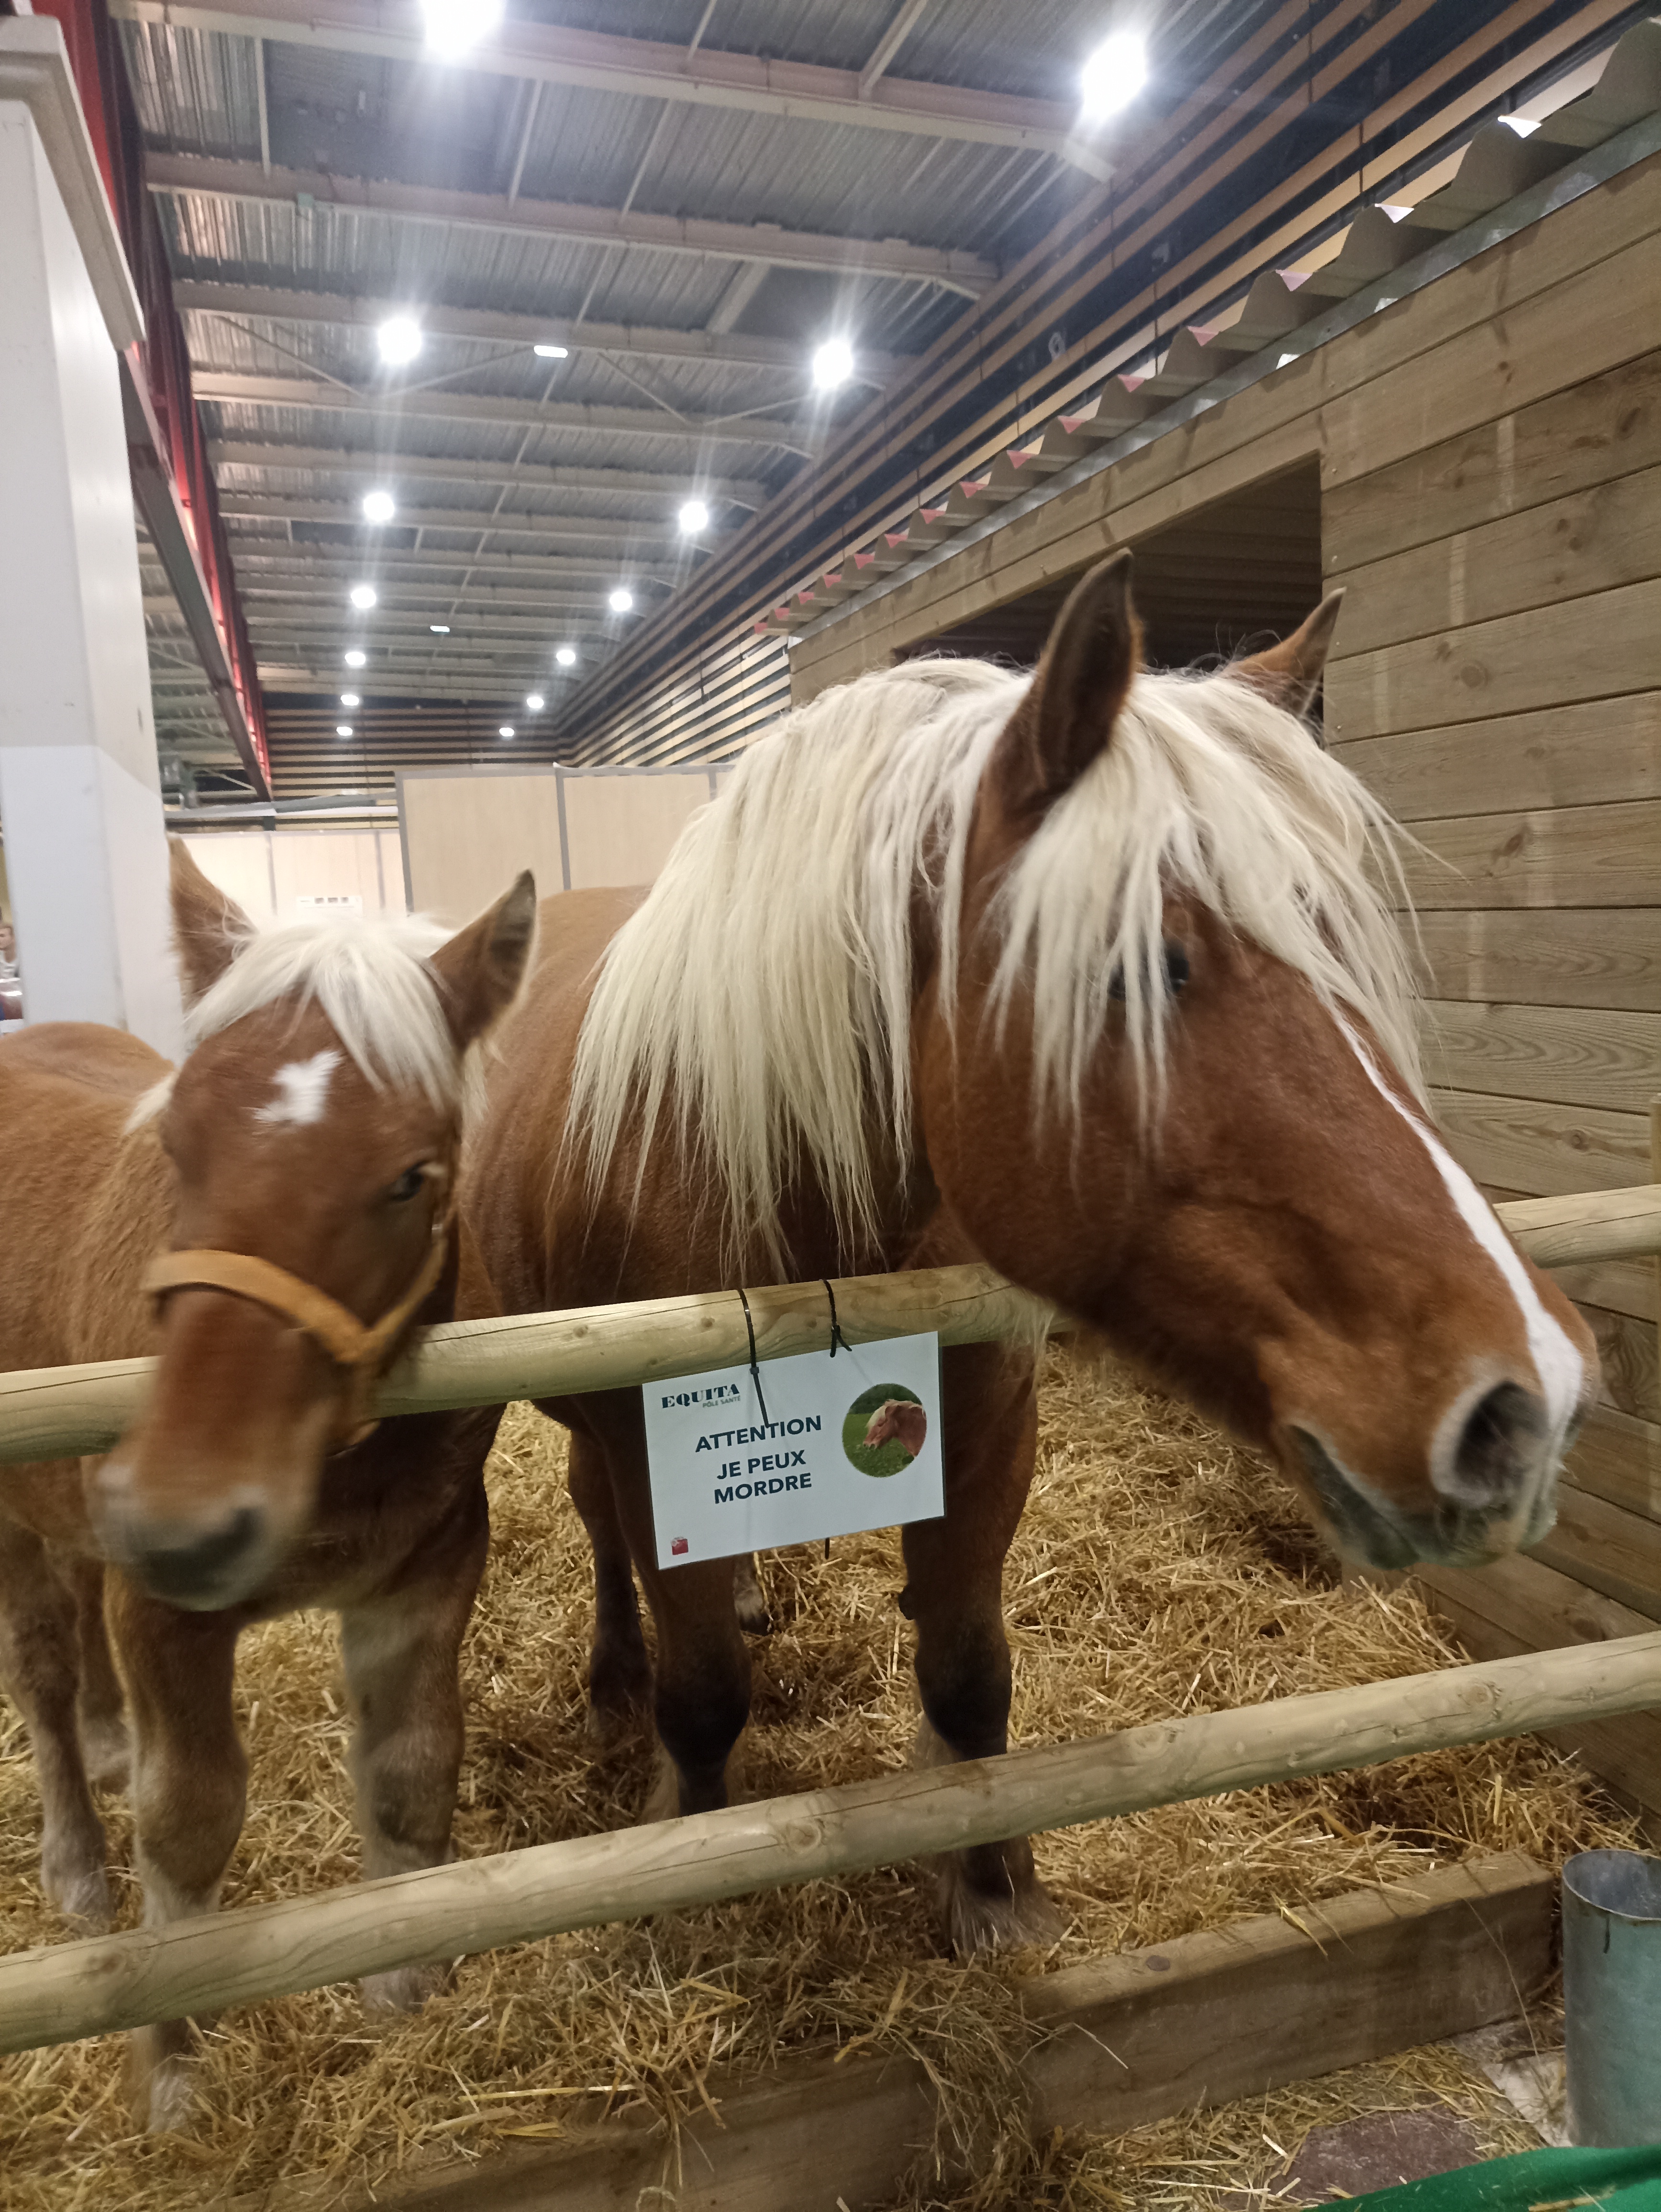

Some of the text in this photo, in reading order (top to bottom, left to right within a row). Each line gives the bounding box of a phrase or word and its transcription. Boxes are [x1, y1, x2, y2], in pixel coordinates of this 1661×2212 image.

[662, 1384, 740, 1408] EQUITA
[702, 1400, 719, 1408] PÔLE
[695, 1415, 821, 1452] ATTENTION
[717, 1449, 806, 1480] JE PEUX
[714, 1472, 812, 1504] MORDRE
